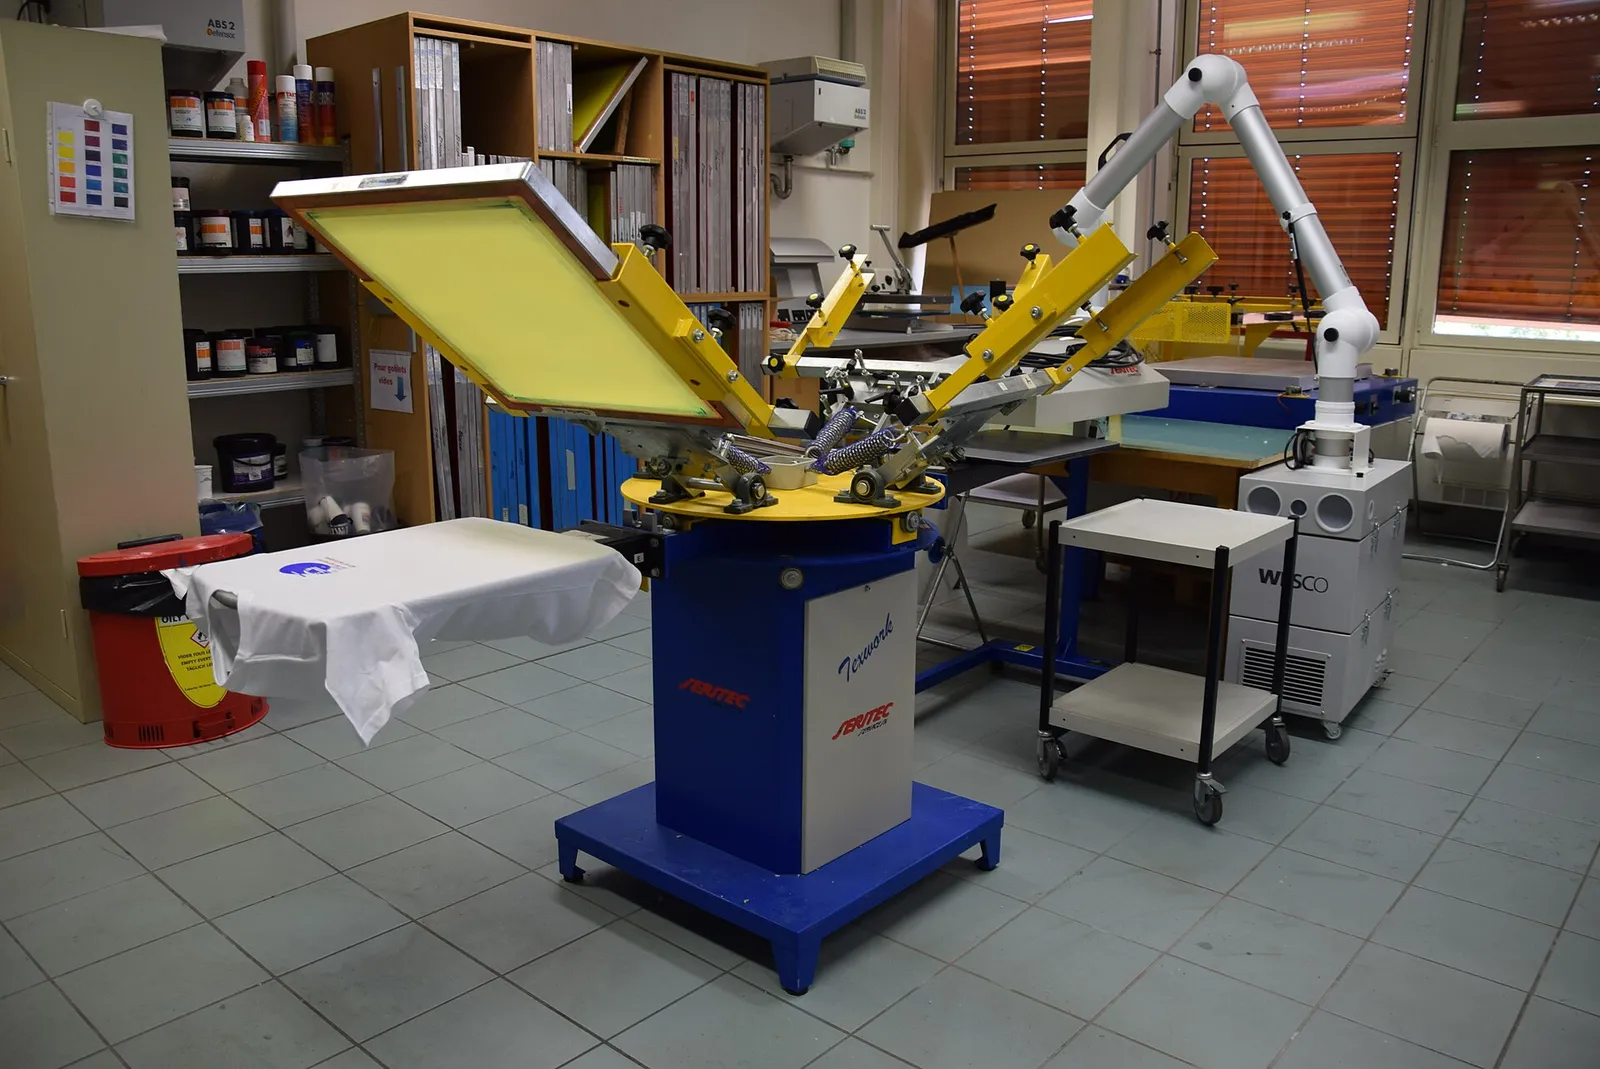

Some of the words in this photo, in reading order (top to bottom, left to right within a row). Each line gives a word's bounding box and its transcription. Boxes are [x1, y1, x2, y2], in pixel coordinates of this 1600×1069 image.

[208, 18, 227, 29] ABS
[229, 21, 235, 31] 2
[378, 376, 393, 386] vides
[387, 364, 407, 374] goblets
[1258, 568, 1329, 593] WSCO
[838, 612, 894, 682] Texwork
[679, 678, 750, 708] SERITEC
[831, 701, 894, 740] SERITEC
